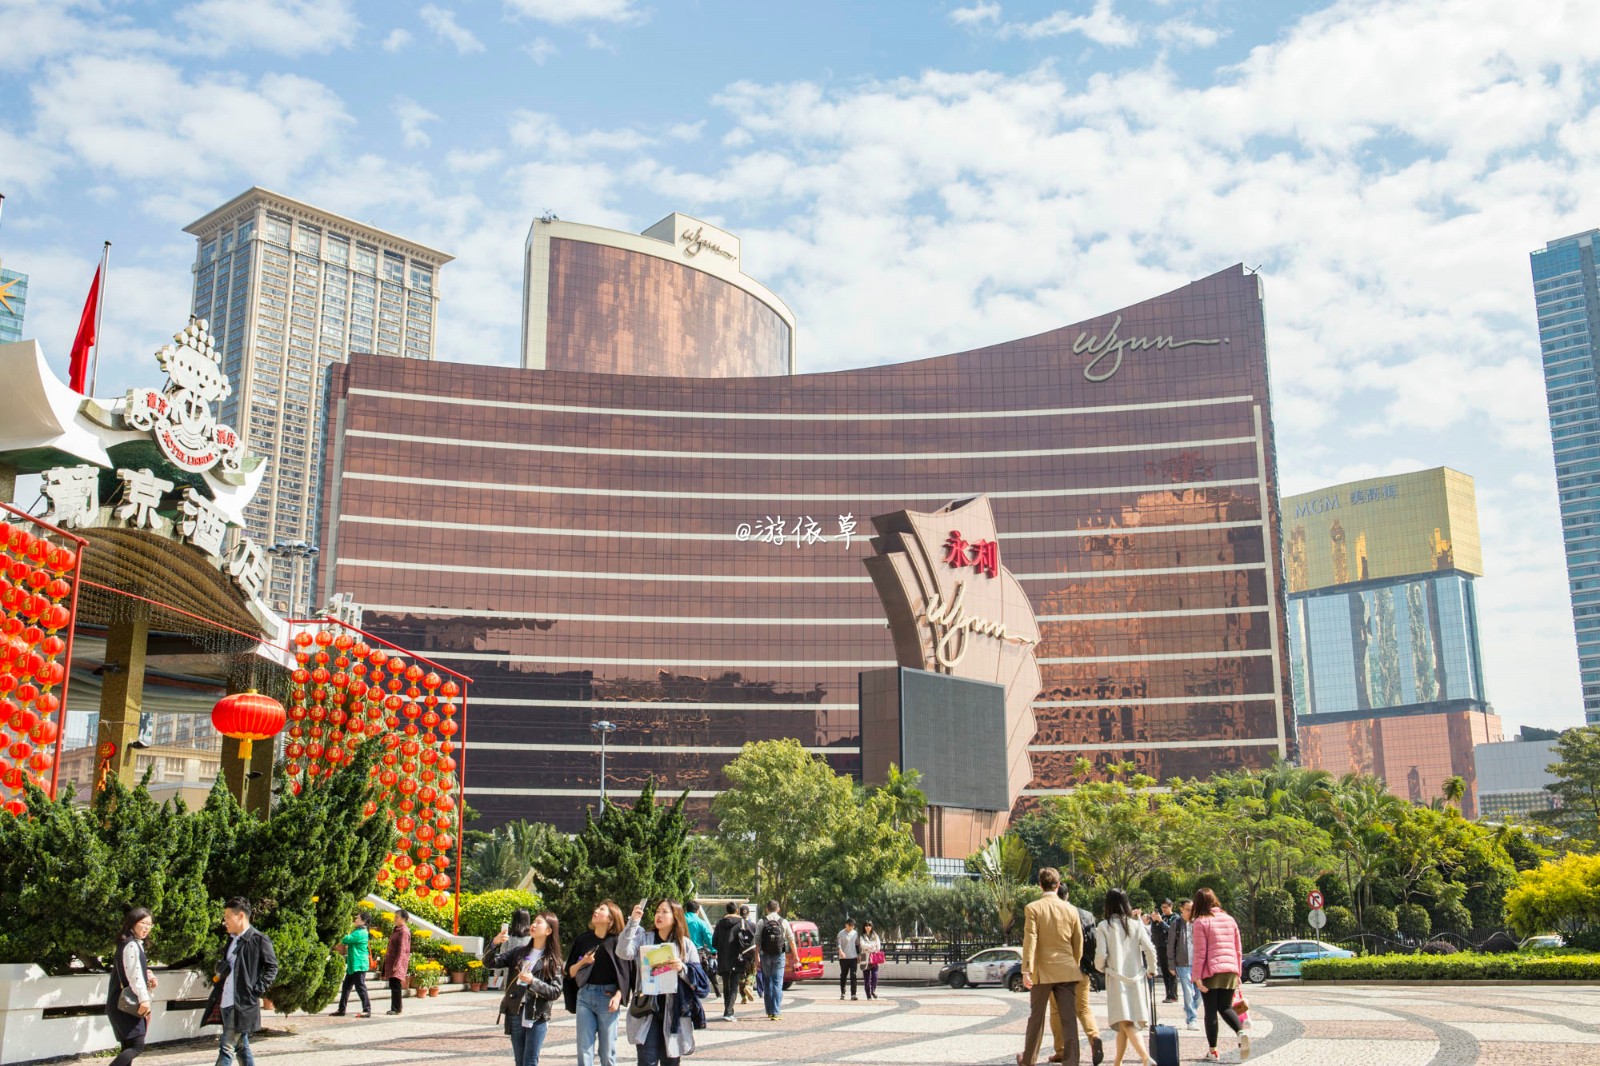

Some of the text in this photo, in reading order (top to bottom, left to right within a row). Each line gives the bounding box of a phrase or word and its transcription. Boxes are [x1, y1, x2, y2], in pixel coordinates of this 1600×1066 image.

[1295, 484, 1398, 519] MGM 美高梅
[943, 530, 999, 578] 永利
